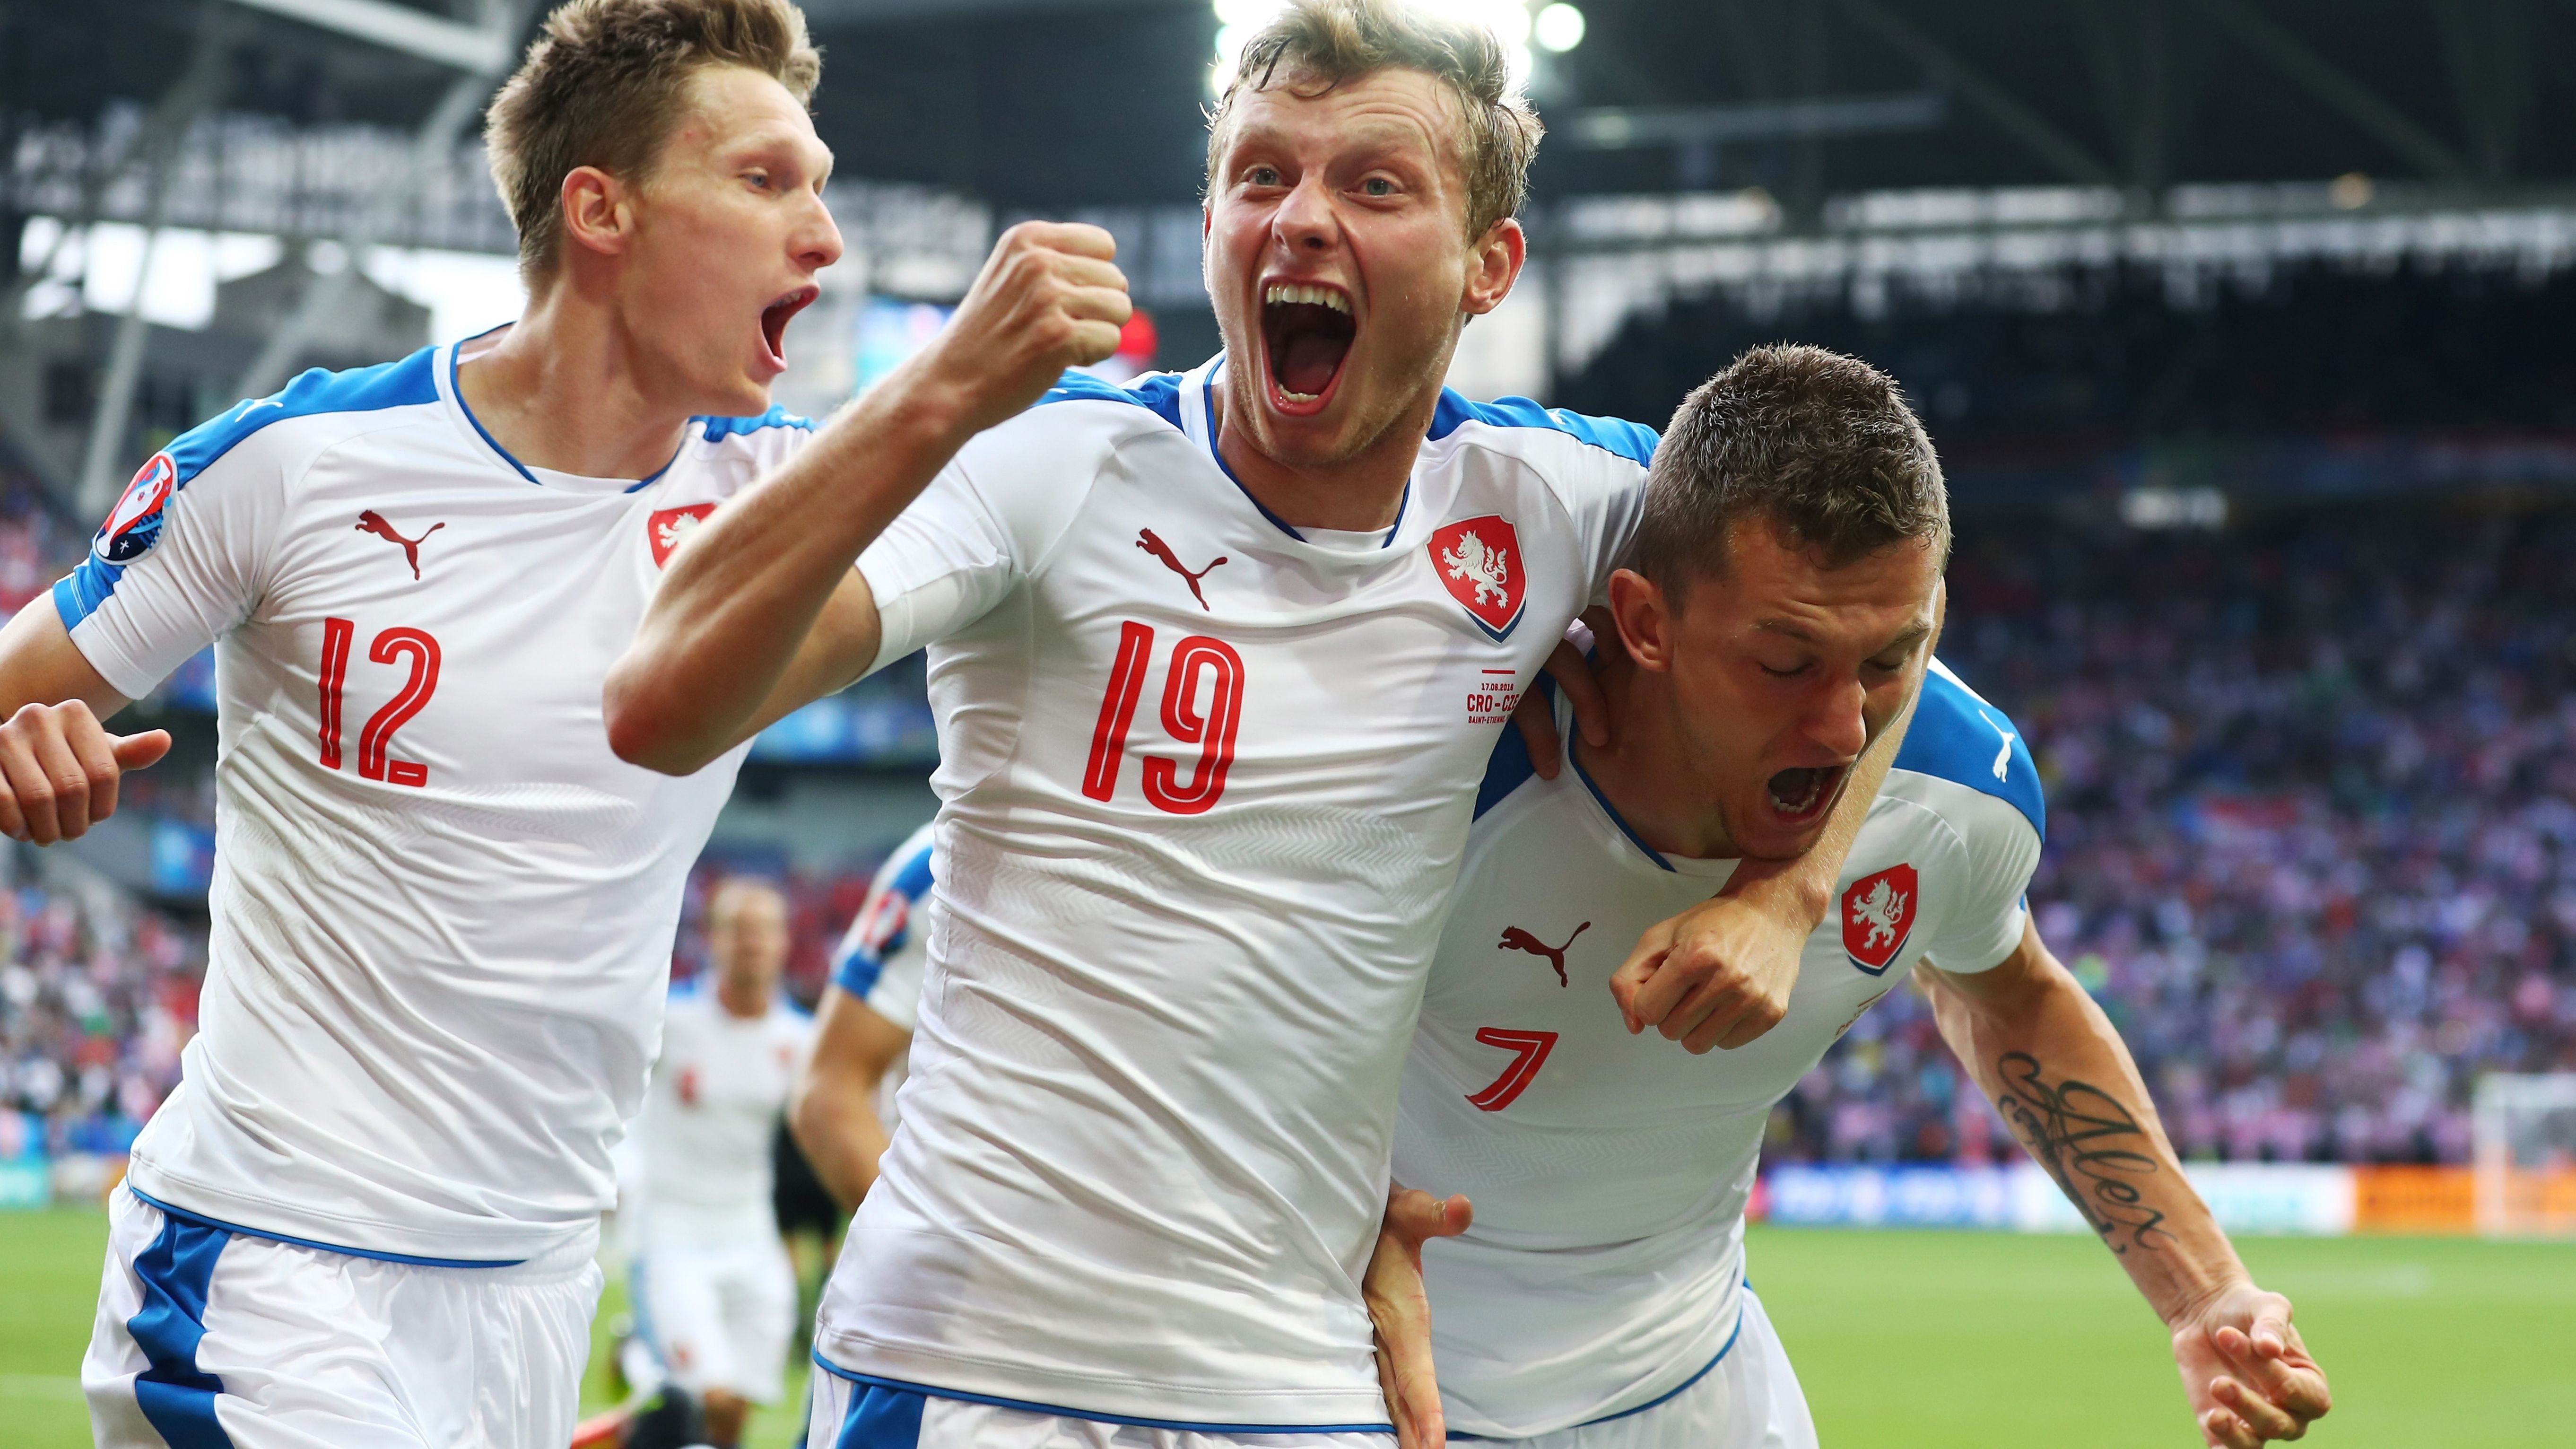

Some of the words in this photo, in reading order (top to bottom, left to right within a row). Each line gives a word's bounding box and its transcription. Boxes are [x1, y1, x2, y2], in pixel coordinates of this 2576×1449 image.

[318, 617, 441, 787] 12
[1082, 620, 1244, 814] 19
[1464, 1027, 1559, 1112] 7
[1997, 1051, 2178, 1251] Alex
